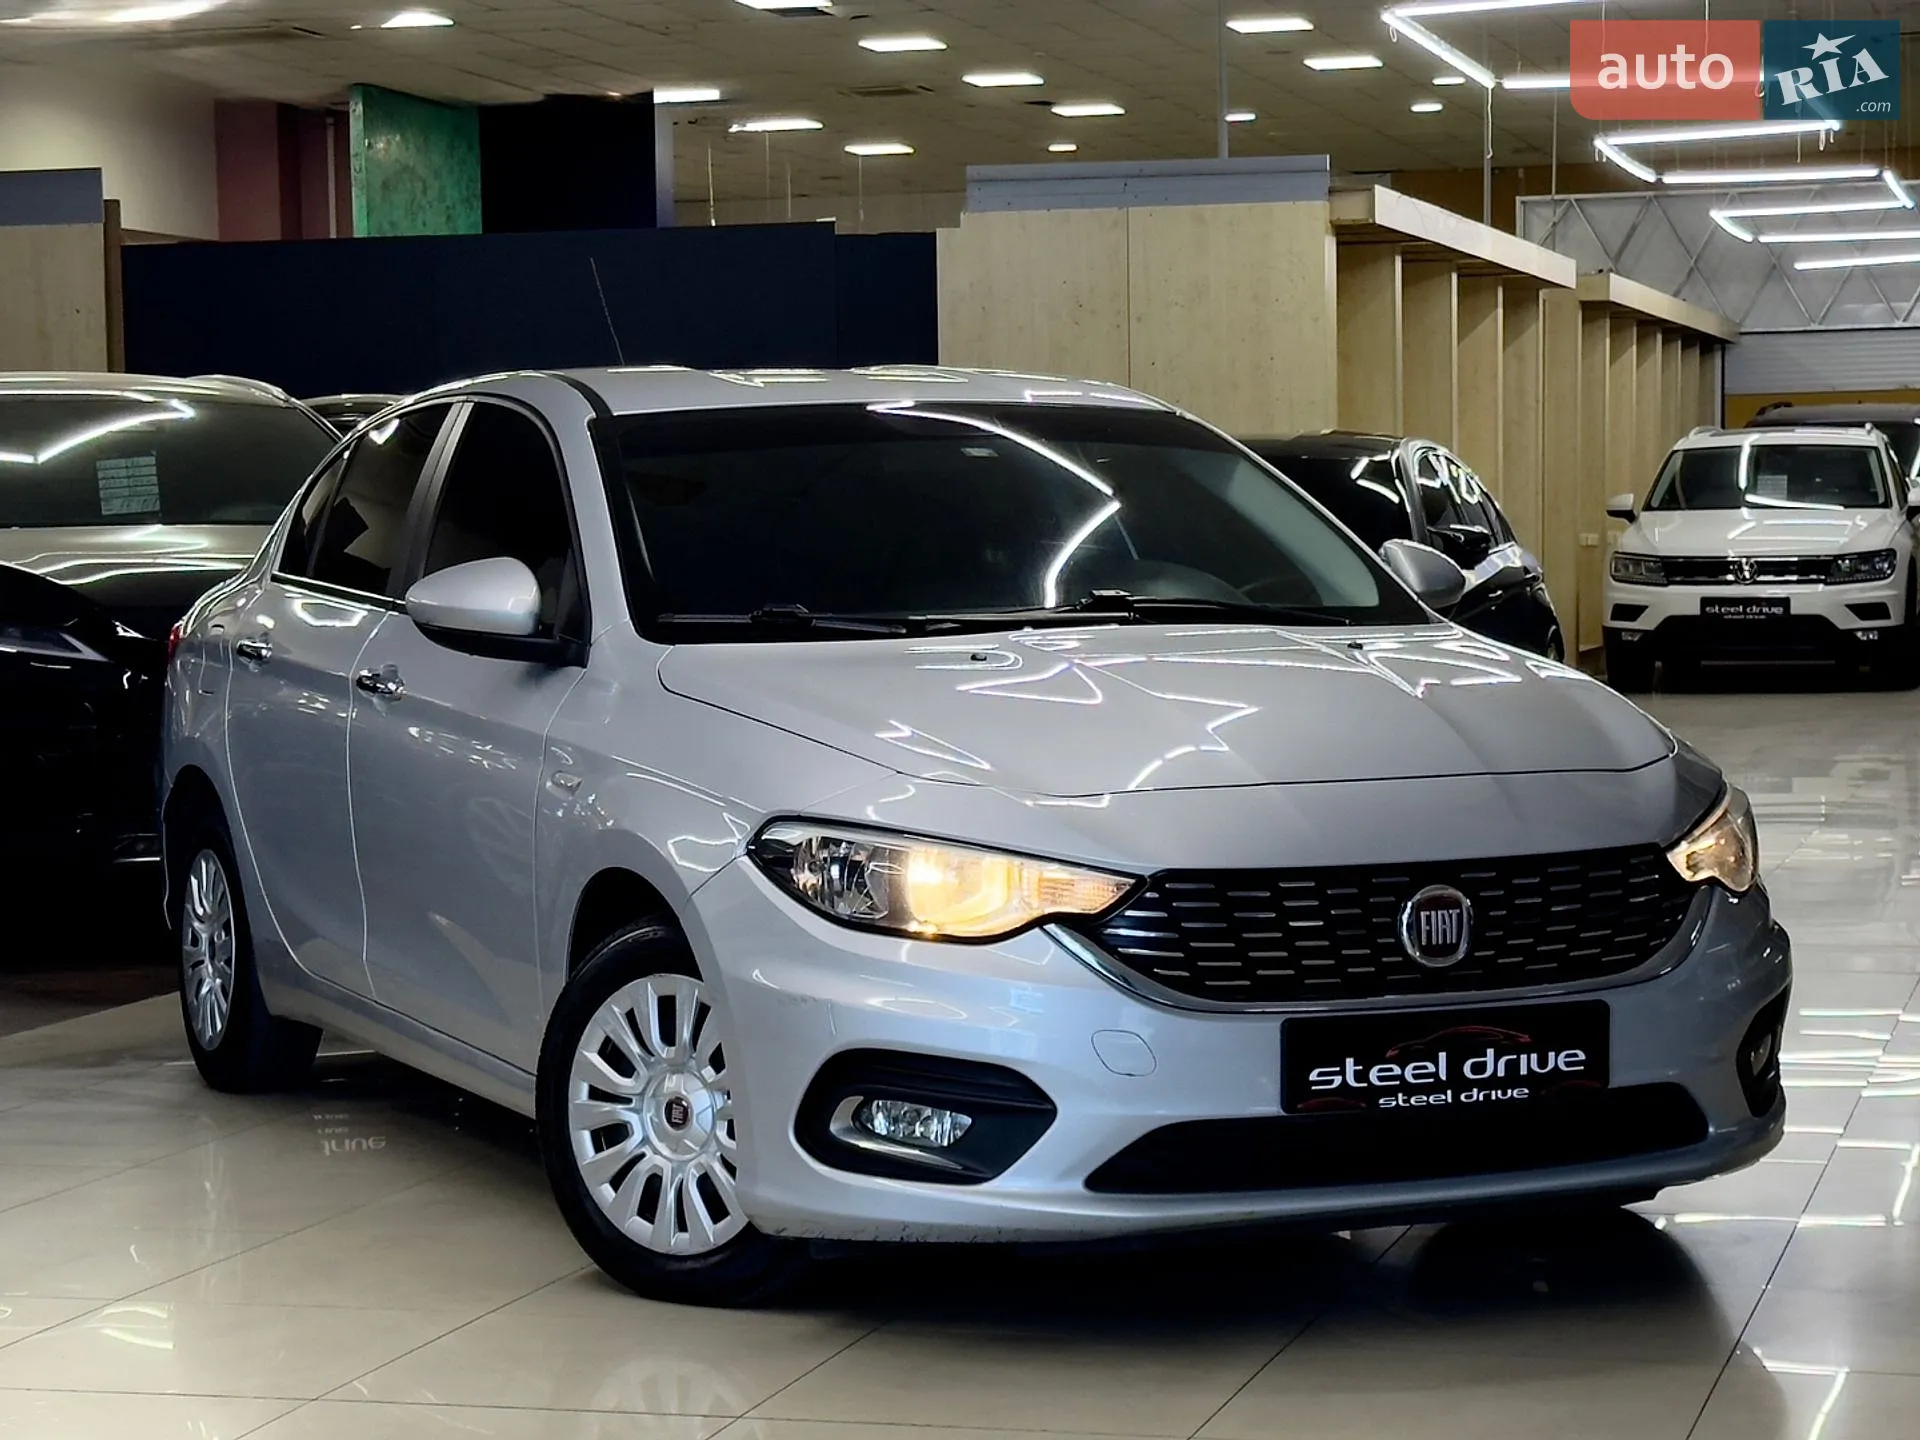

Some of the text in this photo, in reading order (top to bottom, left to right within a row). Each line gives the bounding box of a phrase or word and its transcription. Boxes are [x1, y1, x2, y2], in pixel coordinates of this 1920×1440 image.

[1420, 909, 1460, 946] FIAT
[1308, 1048, 1586, 1090] steel drive
[1378, 1086, 1529, 1108] steel drive
